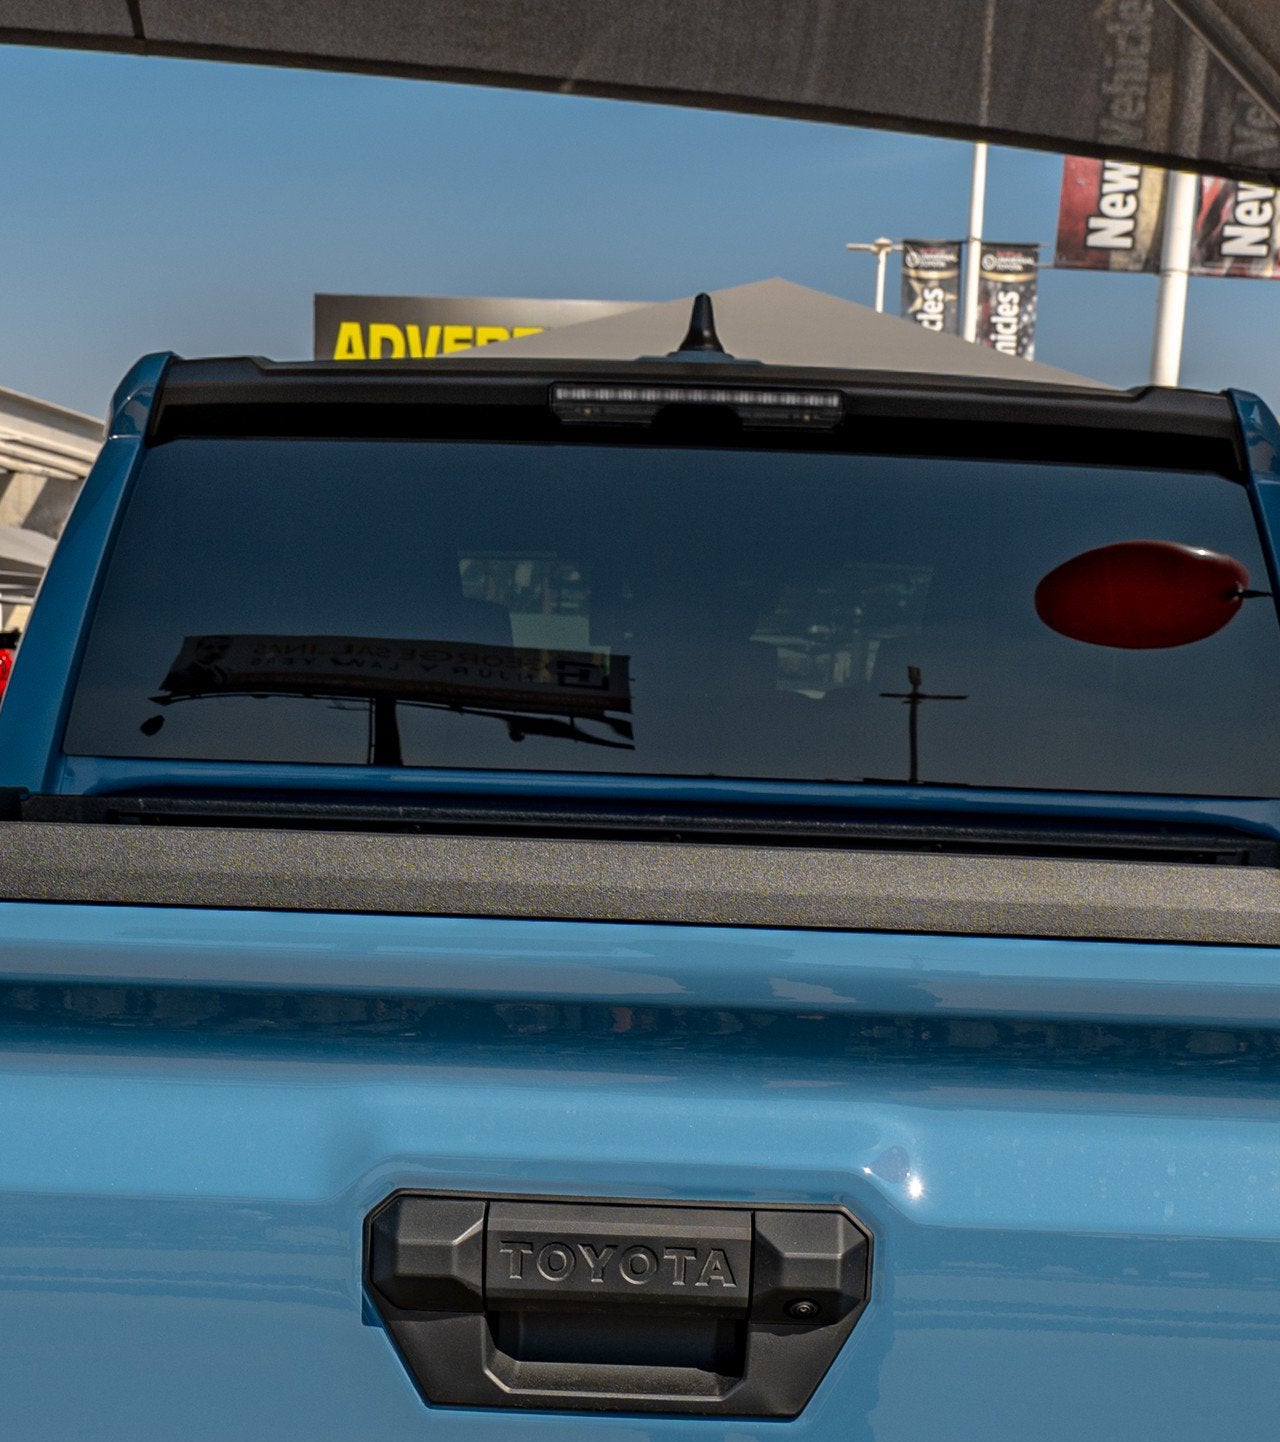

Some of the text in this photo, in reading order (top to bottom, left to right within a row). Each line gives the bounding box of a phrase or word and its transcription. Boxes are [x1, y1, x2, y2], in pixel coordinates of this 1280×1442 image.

[1085, 0, 1154, 250] New Vehicle
[500, 1240, 737, 1288] TOYOTA
